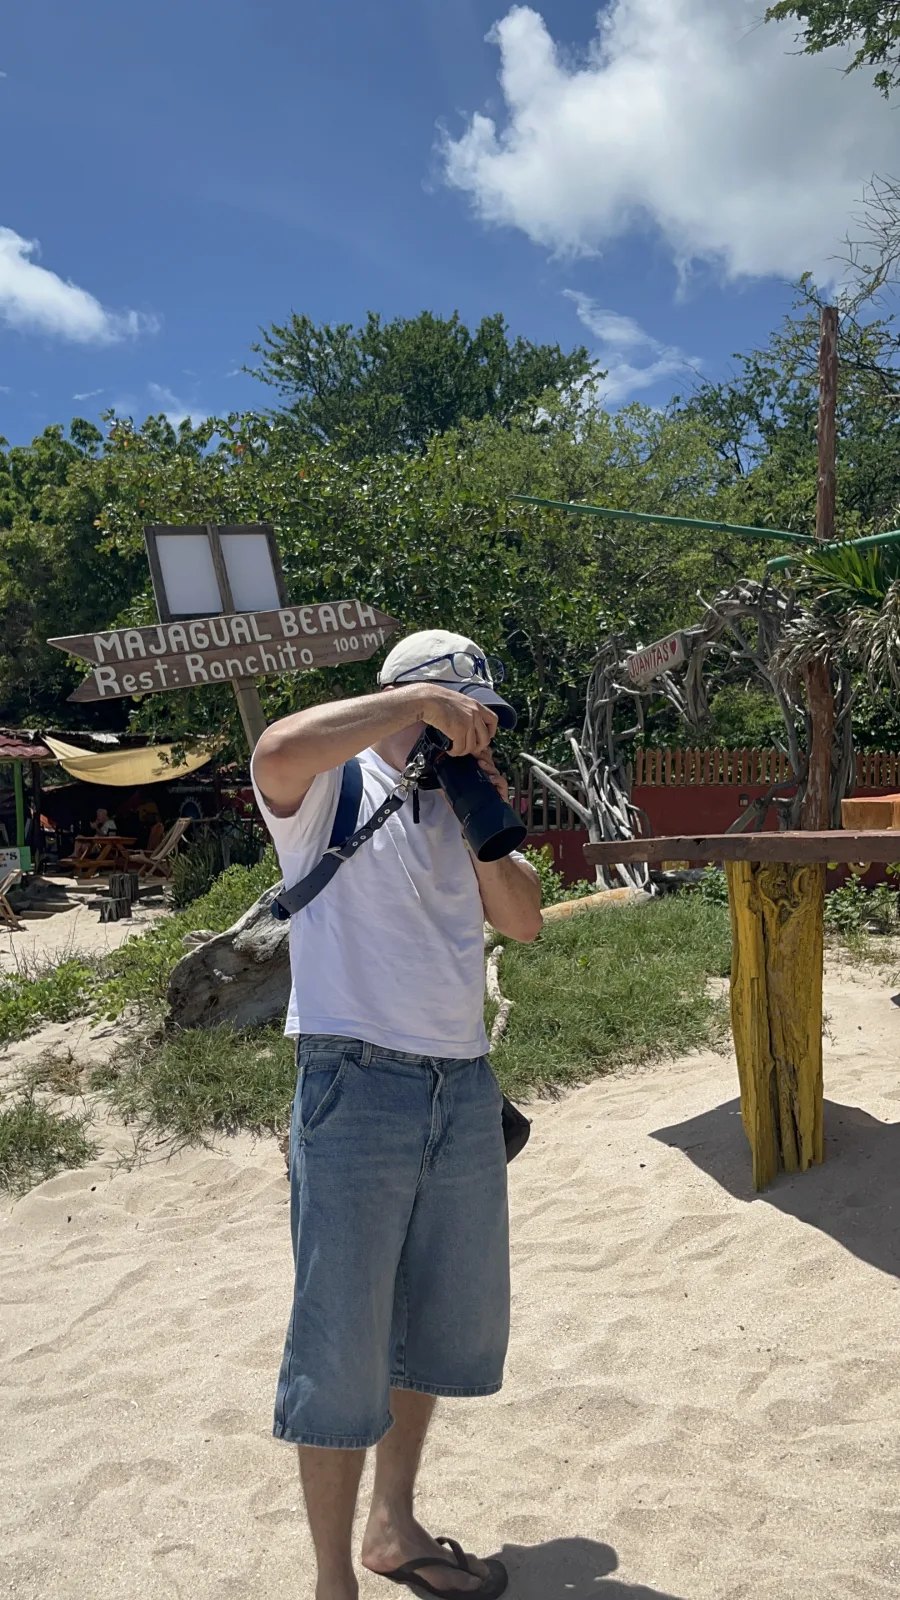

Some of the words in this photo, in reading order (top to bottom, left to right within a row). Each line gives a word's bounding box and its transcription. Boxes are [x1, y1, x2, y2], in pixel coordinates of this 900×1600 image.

[93, 615, 272, 663] MAJAGUAL
[278, 601, 377, 637] BEACH
[333, 636, 359, 652] 100
[361, 627, 385, 648] mt
[93, 659, 179, 696] Rest:
[185, 641, 314, 682] Ranchito
[628, 641, 669, 678] JUANITAS
